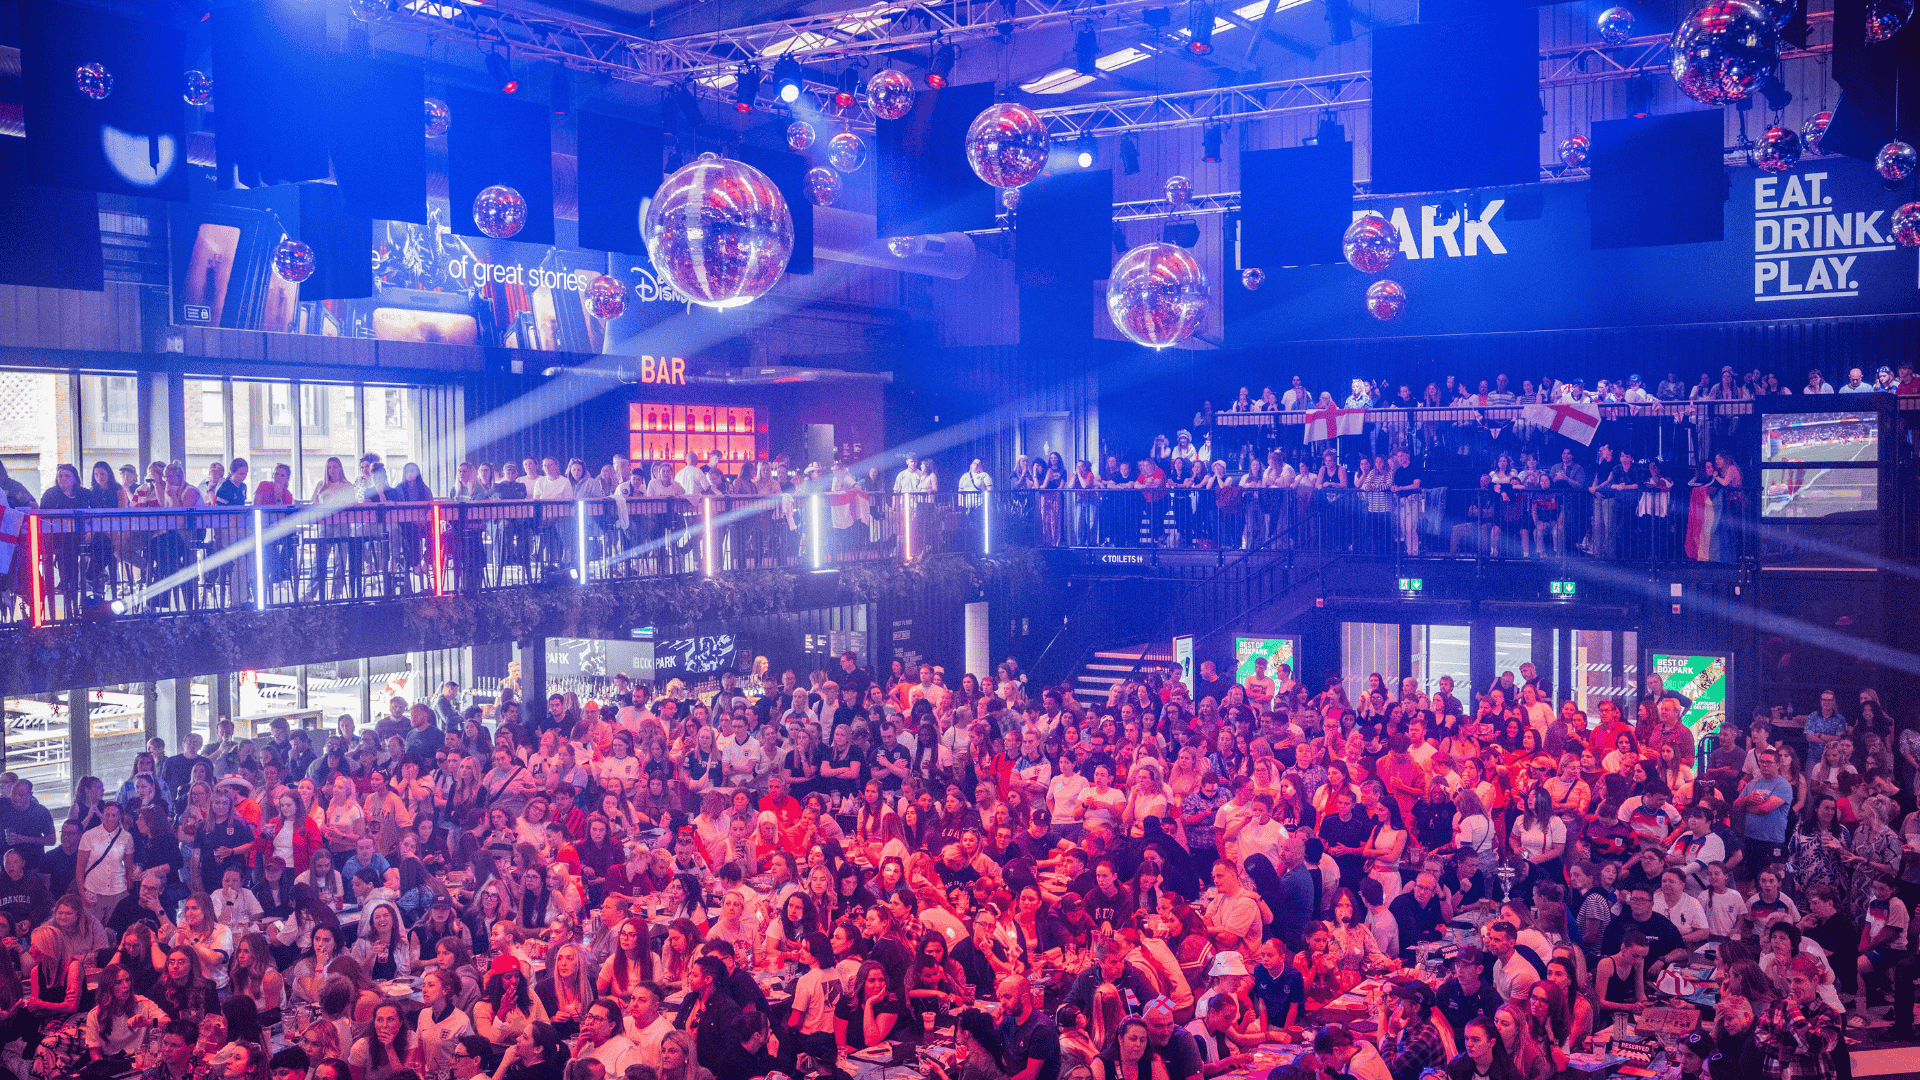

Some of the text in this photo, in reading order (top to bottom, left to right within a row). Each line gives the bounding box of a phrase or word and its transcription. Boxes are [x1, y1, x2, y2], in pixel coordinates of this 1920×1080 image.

[1755, 172, 1833, 210] EAT.
[1353, 200, 1508, 260] ARK
[1755, 210, 1895, 252] DRINK.
[449, 255, 588, 292] of great stories
[1755, 256, 1859, 294] PLAY.
[641, 355, 686, 385] BAR
[1108, 555, 1136, 563] TOILETS
[1239, 641, 1255, 649] BEST
[1239, 648, 1269, 656] BOXPARK
[655, 655, 677, 670] PARK
[1657, 659, 1677, 667] BEST
[1657, 666, 1694, 674] BOXPARK
[1621, 1042, 1650, 1052] RESERVED
